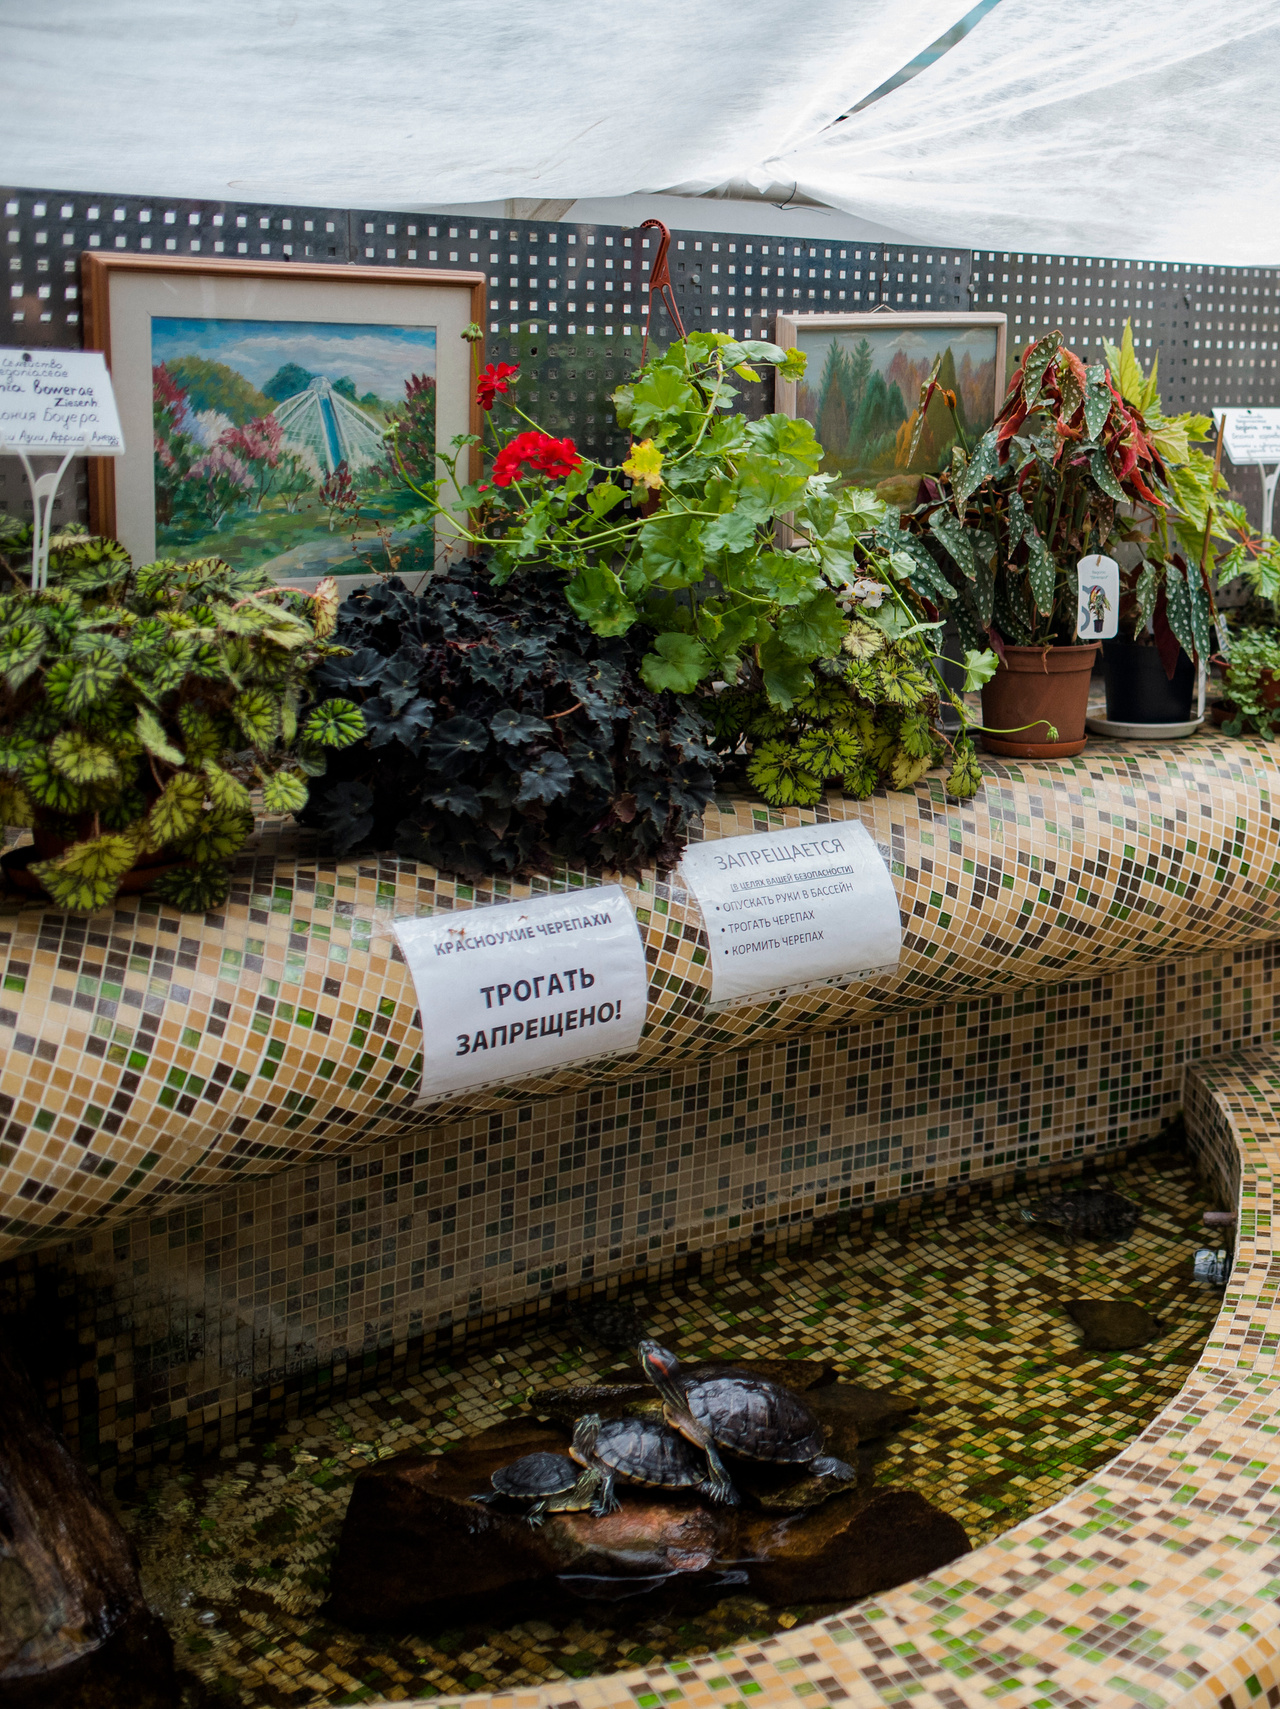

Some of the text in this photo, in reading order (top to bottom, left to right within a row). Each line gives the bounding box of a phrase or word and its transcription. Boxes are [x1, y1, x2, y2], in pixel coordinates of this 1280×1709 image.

[0, 368, 68, 384] egoniaceae
[714, 838, 845, 871] ЗАПРЕЩАЕТСЯ
[740, 879, 766, 890] ЦЕЛЯХ
[765, 873, 793, 885] ВАШЕЙ
[793, 864, 855, 881] БЕЗОПАСНОСТИ)
[722, 881, 854, 913] ОПУСКАТЬ РУКИ В БАССЕЙН
[433, 912, 613, 956] КРАСНОУХИЕ ЧЕРЕПАХИ
[728, 910, 816, 934] ТРОГАТЬ ЧЕРЕПАХ
[731, 930, 825, 956] КОРМИТЬ ЧЕРЕПАХ
[479, 967, 596, 1010] ТРОГАТЬ
[455, 999, 623, 1057] ЗАПРЕЩЕНО!
